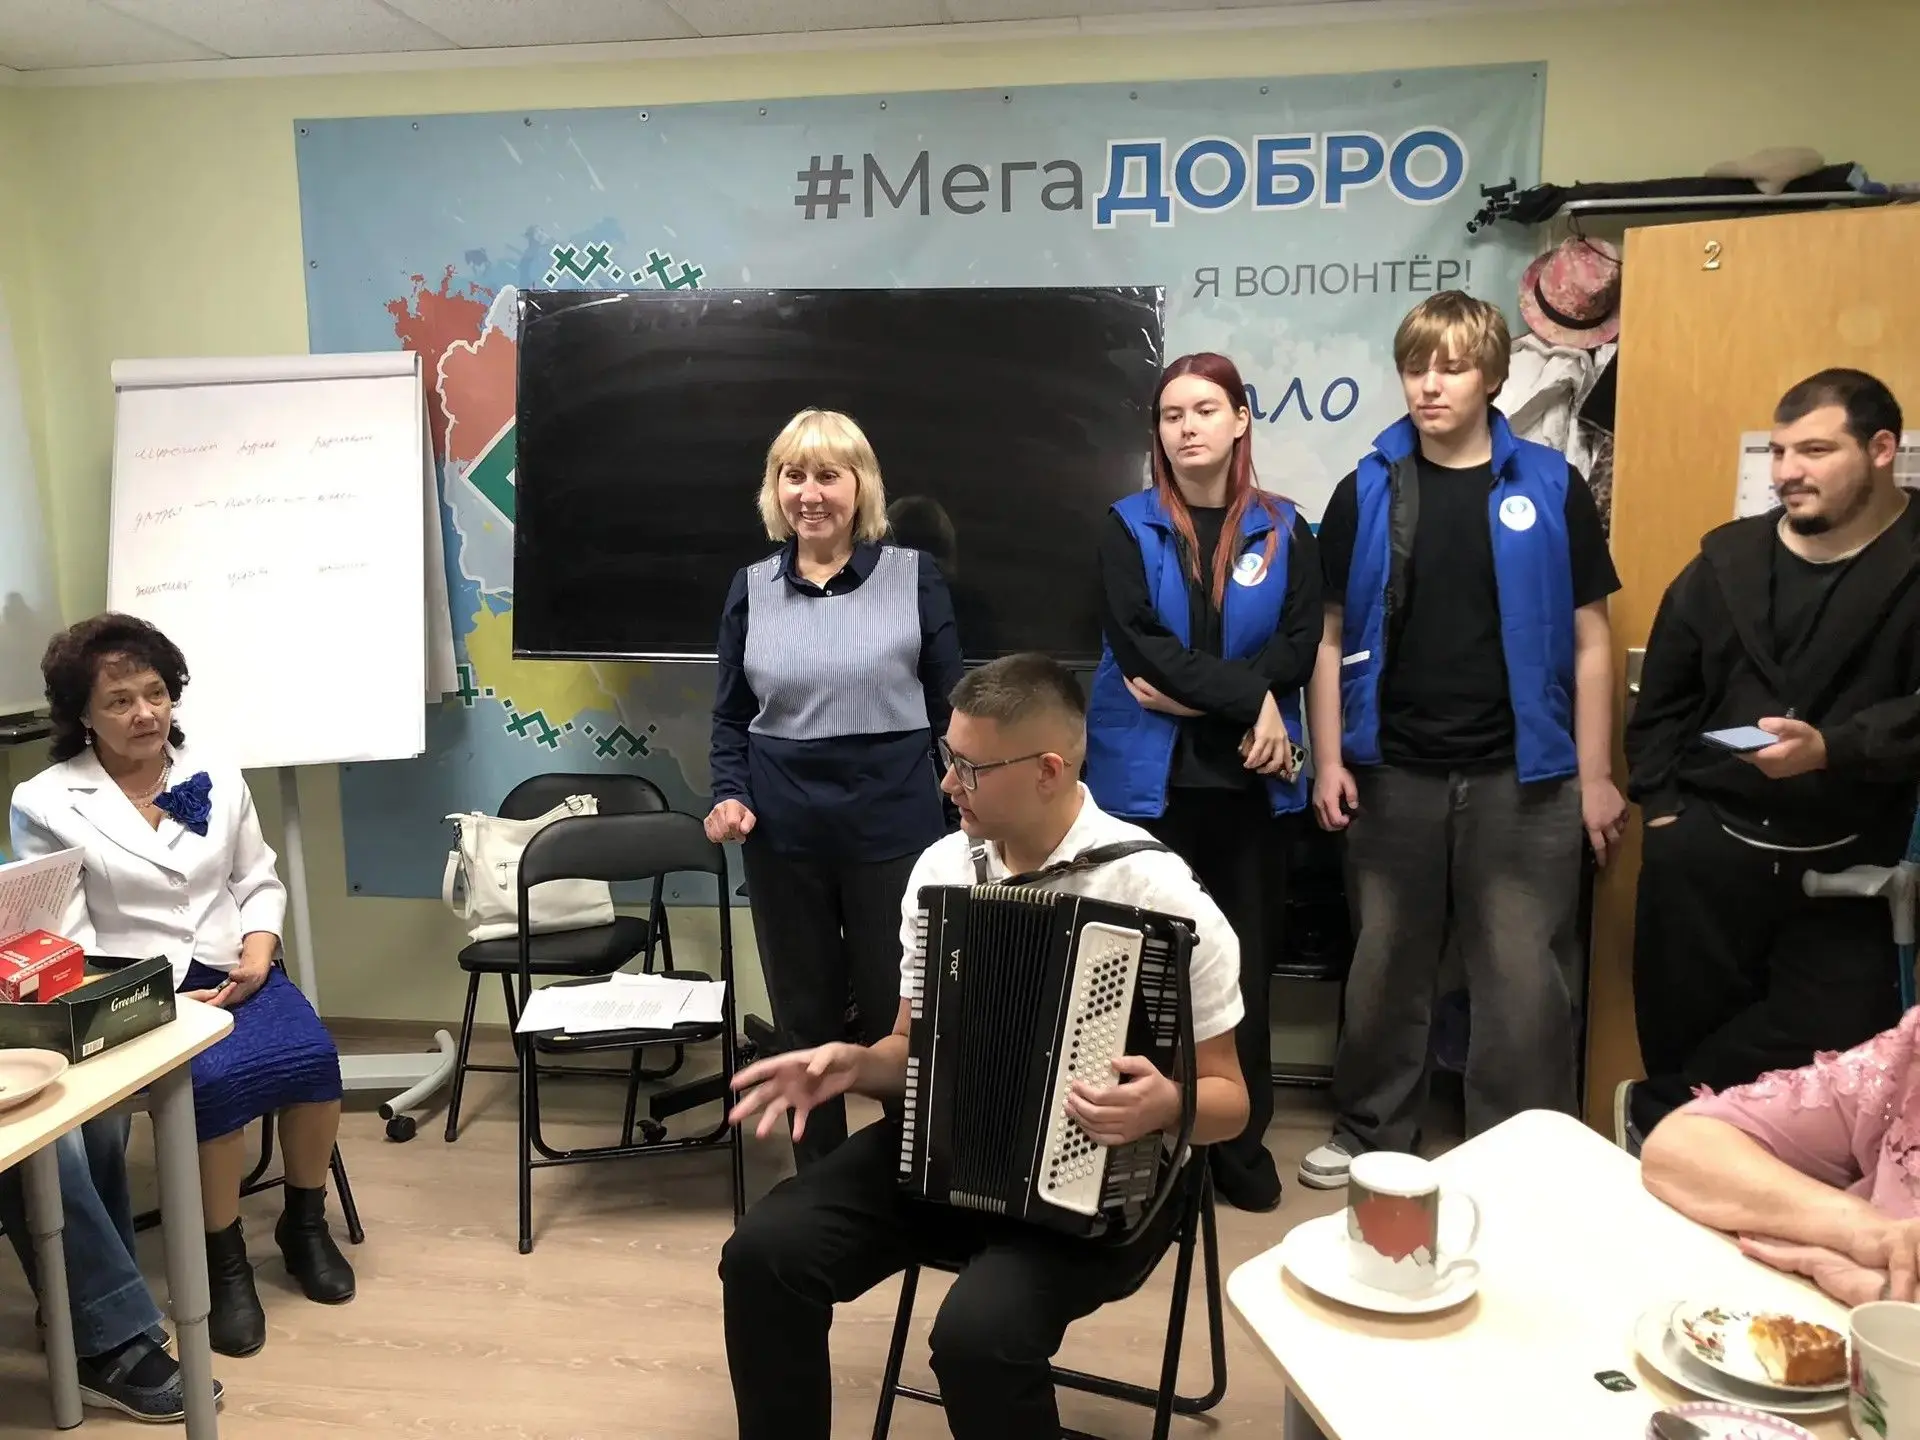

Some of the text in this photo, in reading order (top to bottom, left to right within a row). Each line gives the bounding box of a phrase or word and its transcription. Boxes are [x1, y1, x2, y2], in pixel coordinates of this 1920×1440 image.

[794, 126, 1467, 229] #МегаДОБРО
[1701, 240, 1723, 270] 2
[1193, 254, 1472, 298] Я ВОЛОНТЁР!
[111, 983, 151, 1012] Greenfield
